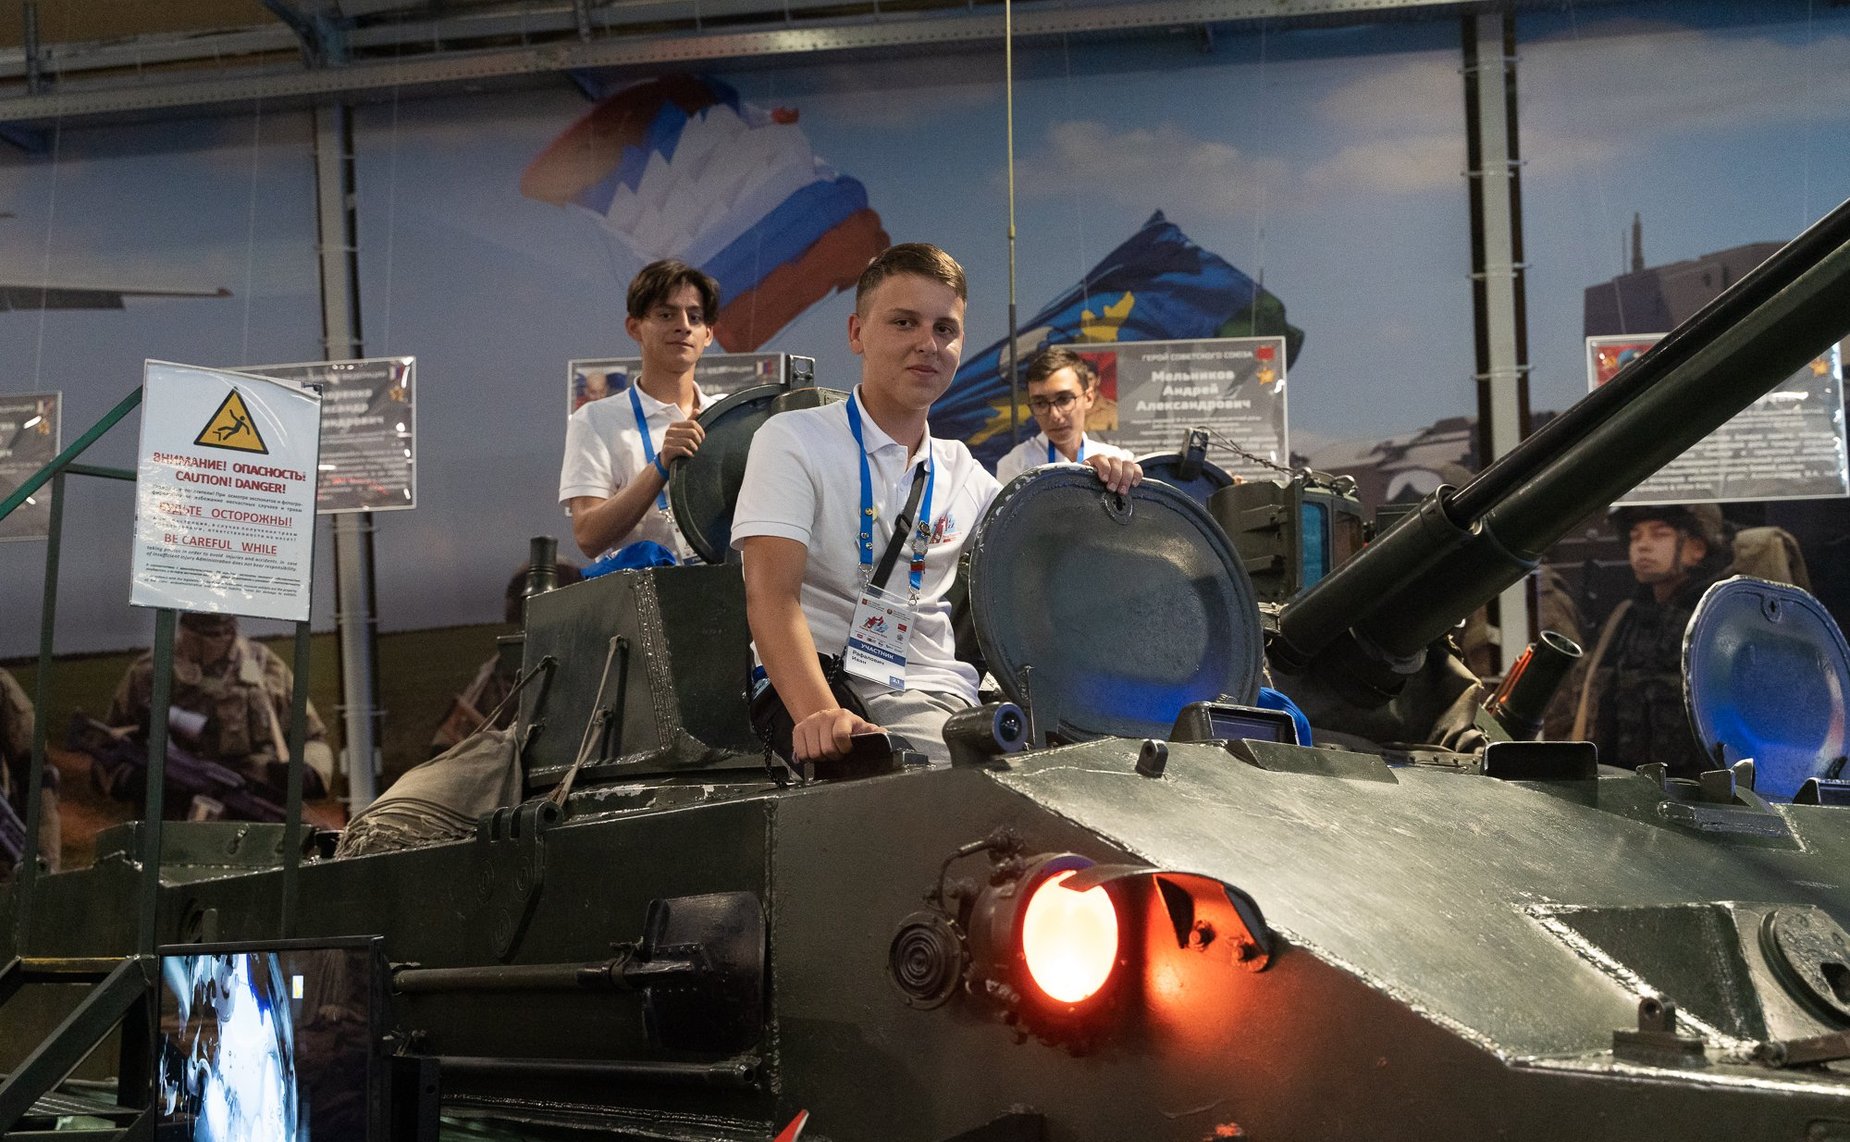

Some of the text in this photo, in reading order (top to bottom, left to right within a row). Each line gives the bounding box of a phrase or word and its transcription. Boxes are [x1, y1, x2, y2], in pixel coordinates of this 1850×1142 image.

[1151, 370, 1235, 382] Мельников
[1162, 383, 1219, 397] Андрей
[1135, 399, 1251, 412] Александрович
[153, 452, 307, 482] ВНИМАНИЕ! ОПАСНОСТЬ!
[175, 470, 232, 487] CAUTION!
[235, 478, 286, 494] DANGER!
[211, 508, 293, 526] ОСТОРОЖНЫ!
[164, 533, 278, 555] BE CAREFUL WHILE
[861, 643, 894, 660] УЧАСТНИК
